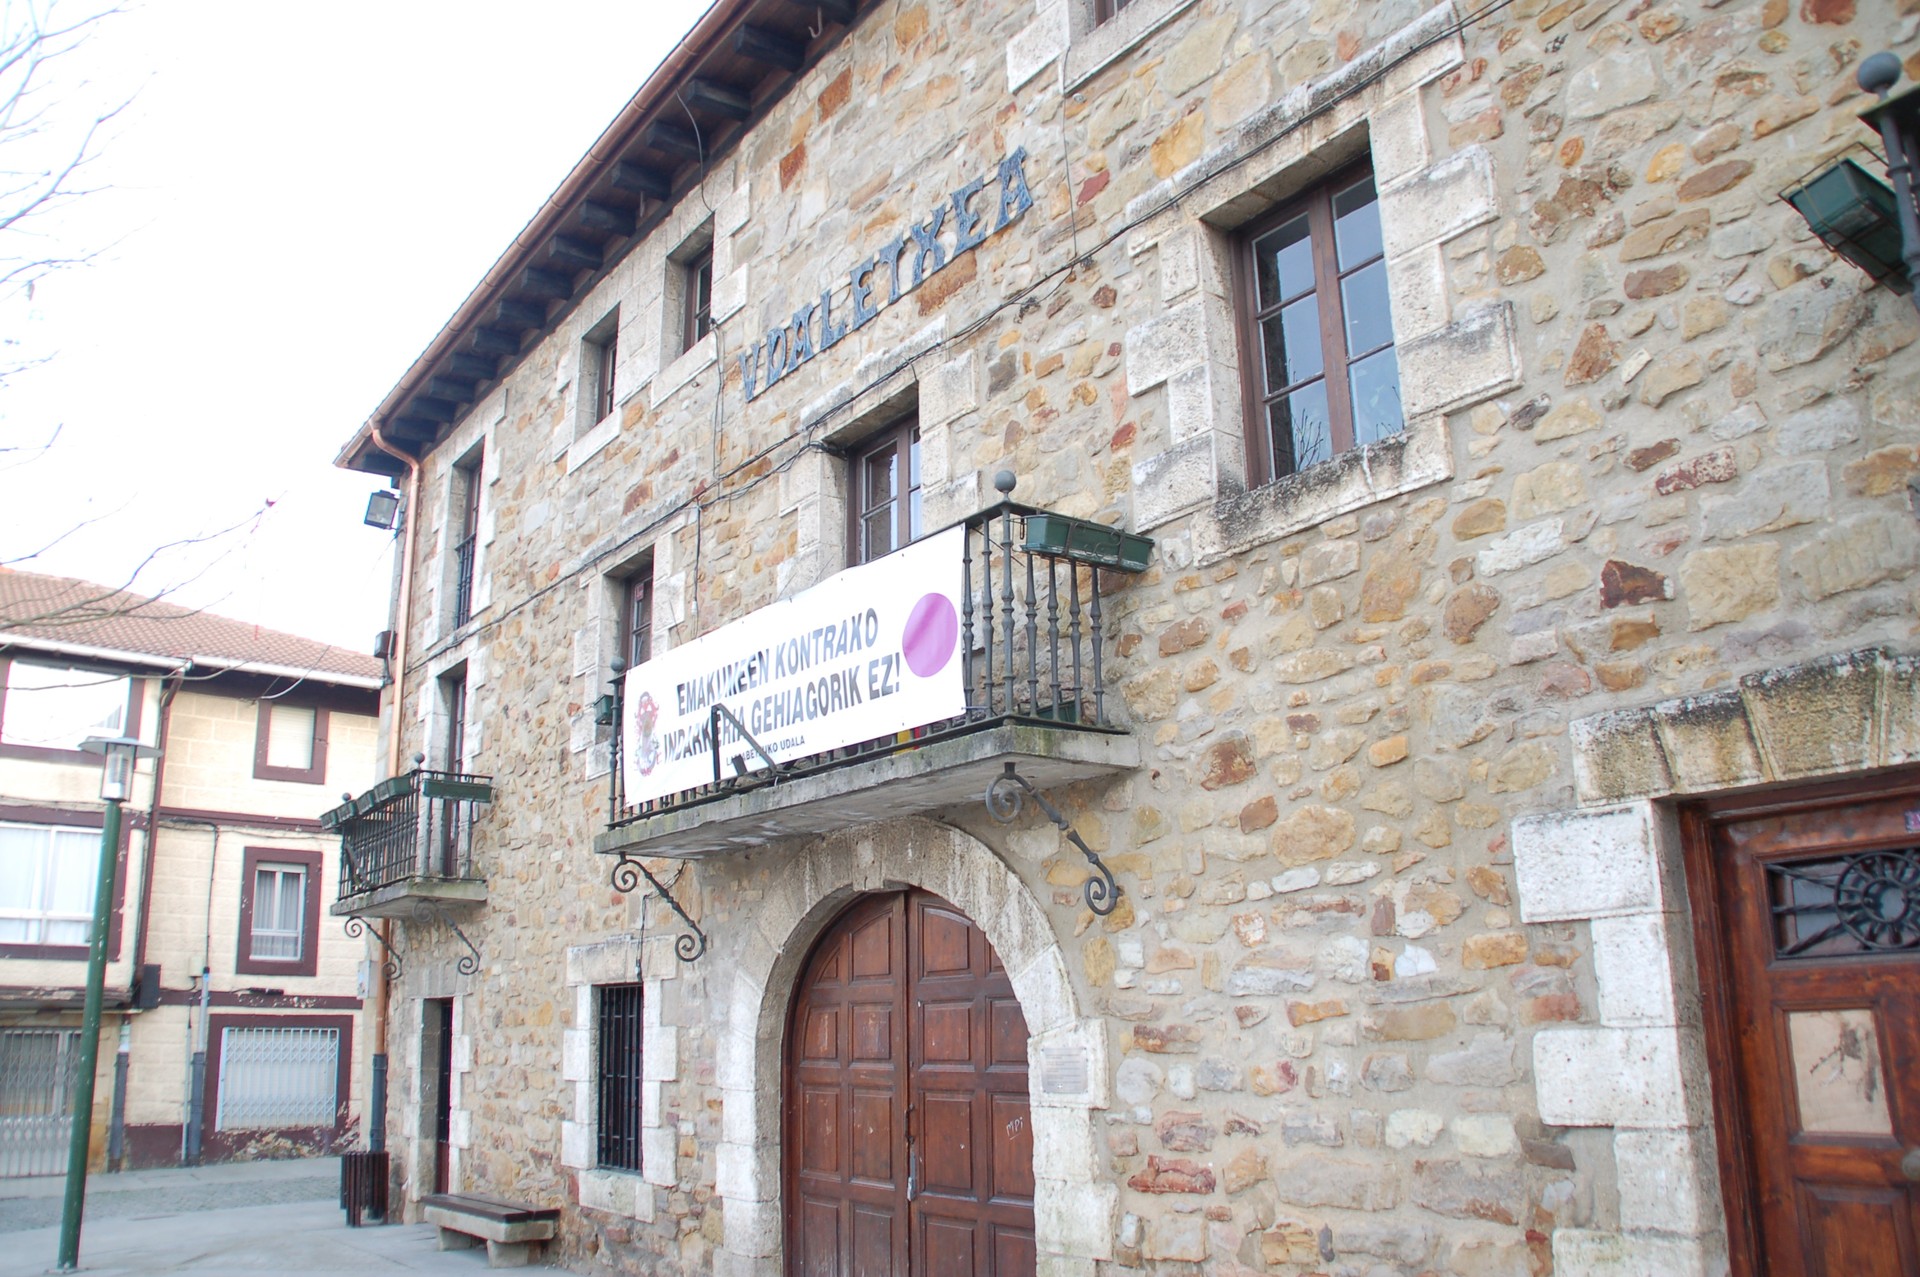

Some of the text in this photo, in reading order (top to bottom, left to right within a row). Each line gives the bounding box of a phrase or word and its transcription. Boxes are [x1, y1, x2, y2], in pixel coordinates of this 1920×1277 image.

[676, 607, 879, 717] EMAKUMEEN KONTRAKO
[750, 665, 863, 737] GEHIAGORIK
[867, 652, 901, 701] EZ!
[779, 735, 806, 751] UDALA
